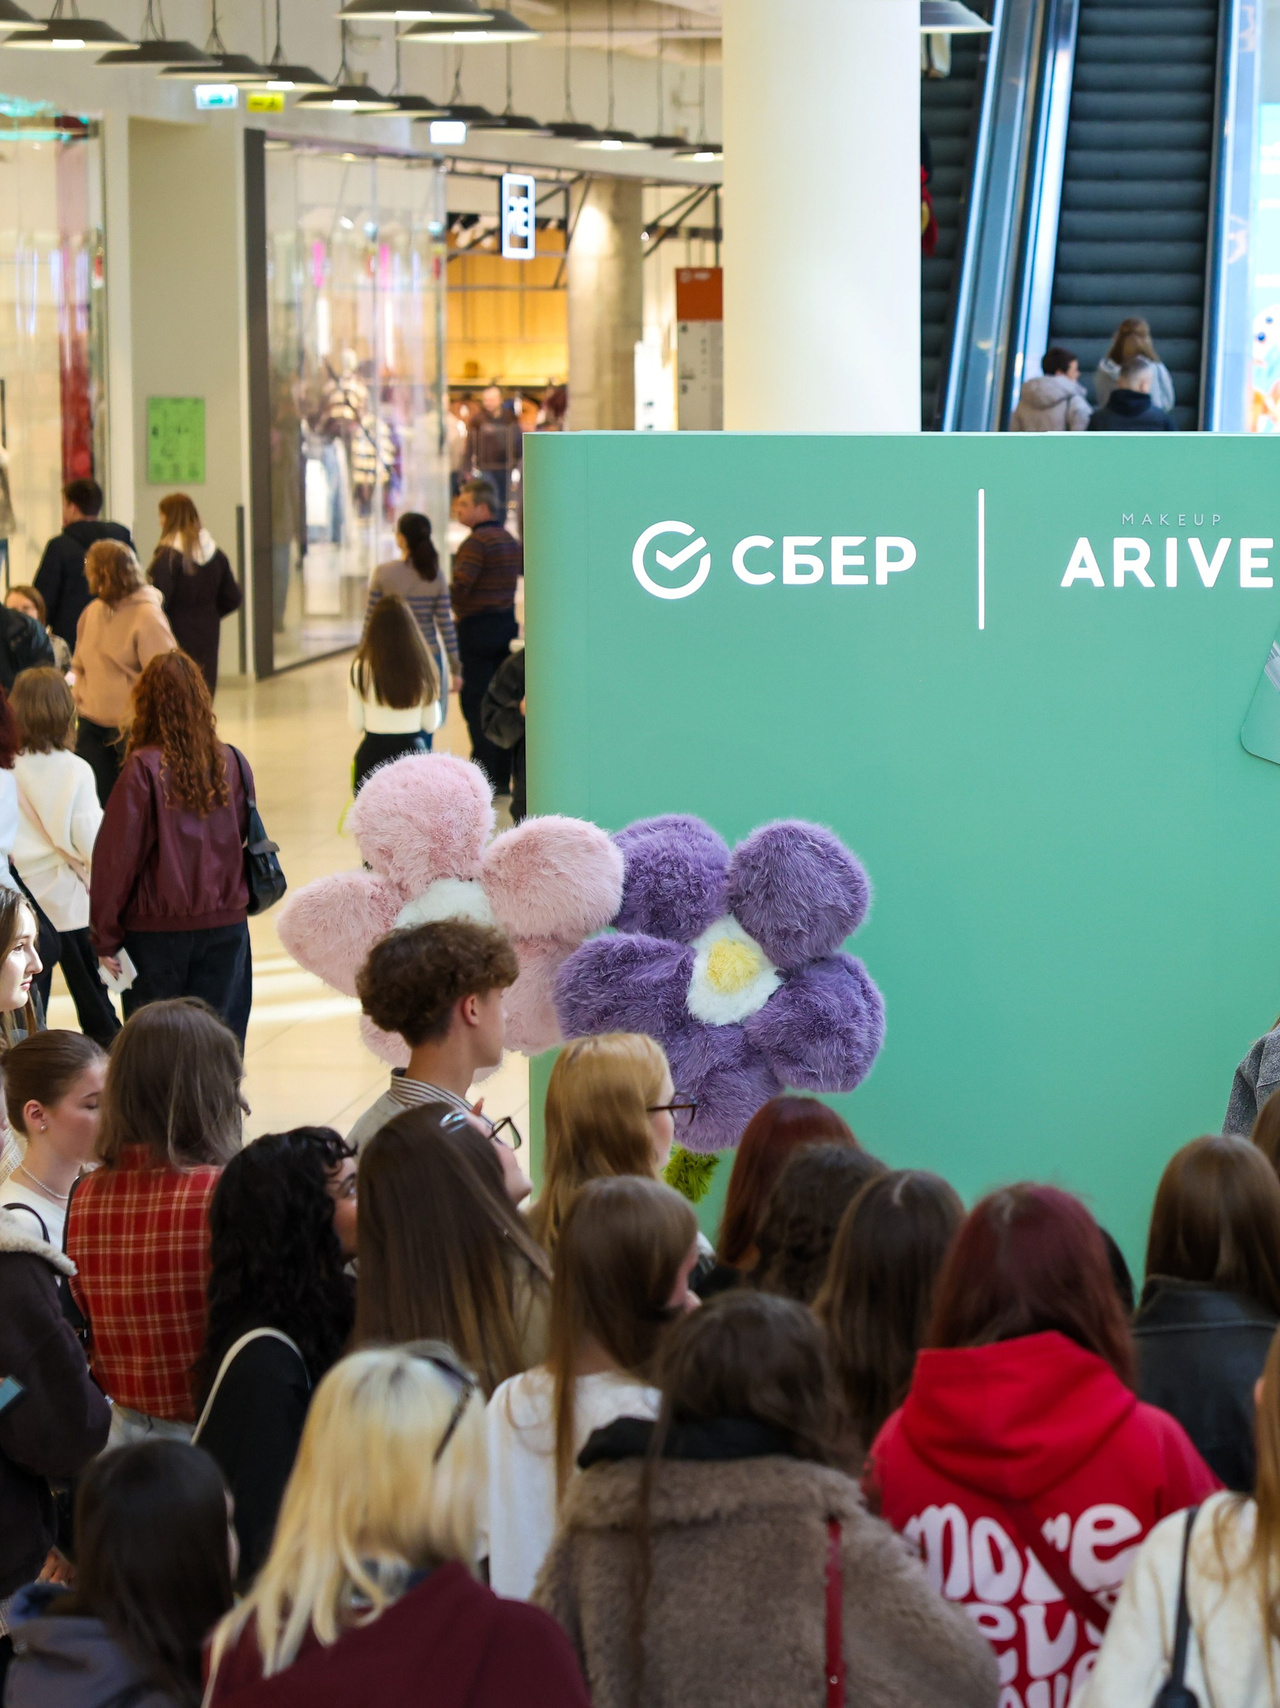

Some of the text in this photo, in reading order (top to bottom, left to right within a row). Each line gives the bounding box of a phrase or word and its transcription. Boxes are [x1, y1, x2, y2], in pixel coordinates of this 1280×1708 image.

[1121, 513, 1222, 526] MAKEUP
[731, 535, 917, 585] СБЕР
[1060, 536, 1274, 588] ARIVE
